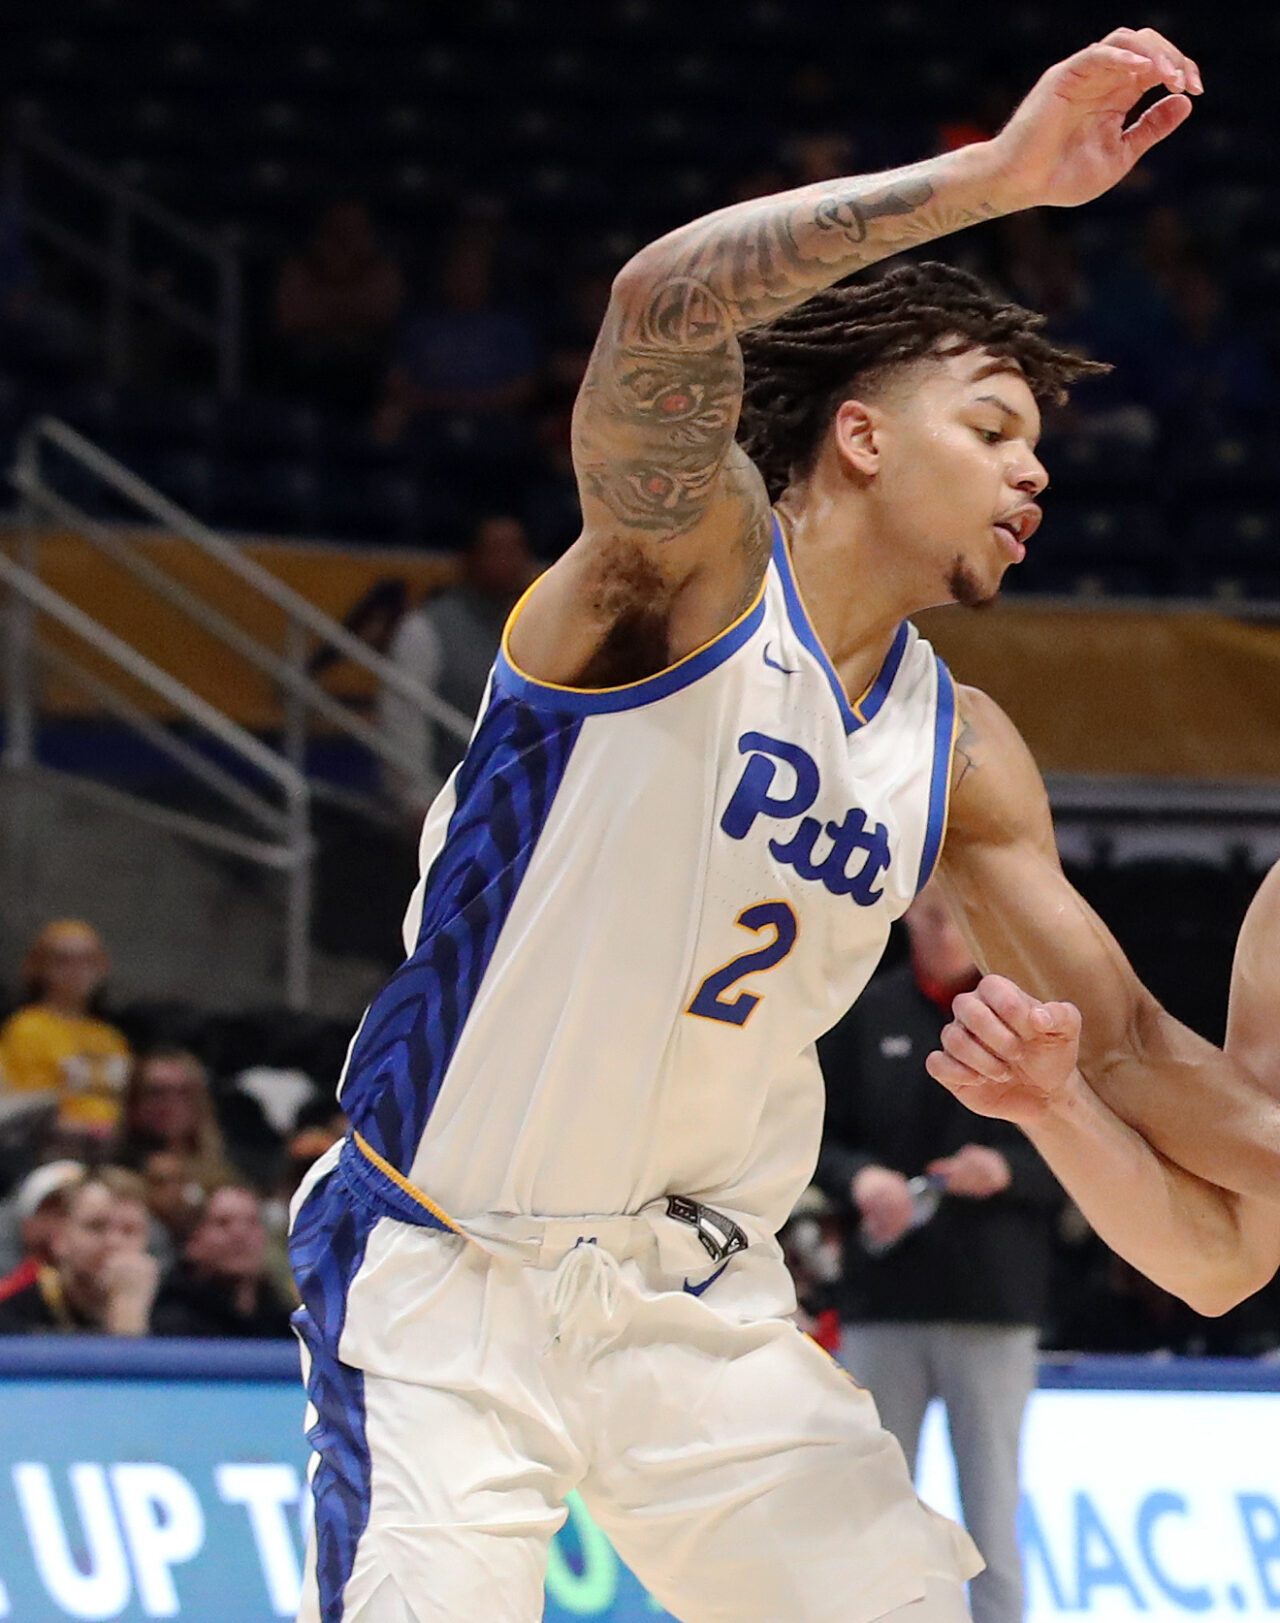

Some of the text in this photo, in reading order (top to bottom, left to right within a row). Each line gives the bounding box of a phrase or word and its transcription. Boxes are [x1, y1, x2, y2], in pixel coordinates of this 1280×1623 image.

[721, 731, 891, 906] Pitt
[685, 899, 800, 1027] 2
[11, 1461, 317, 1621] UP T
